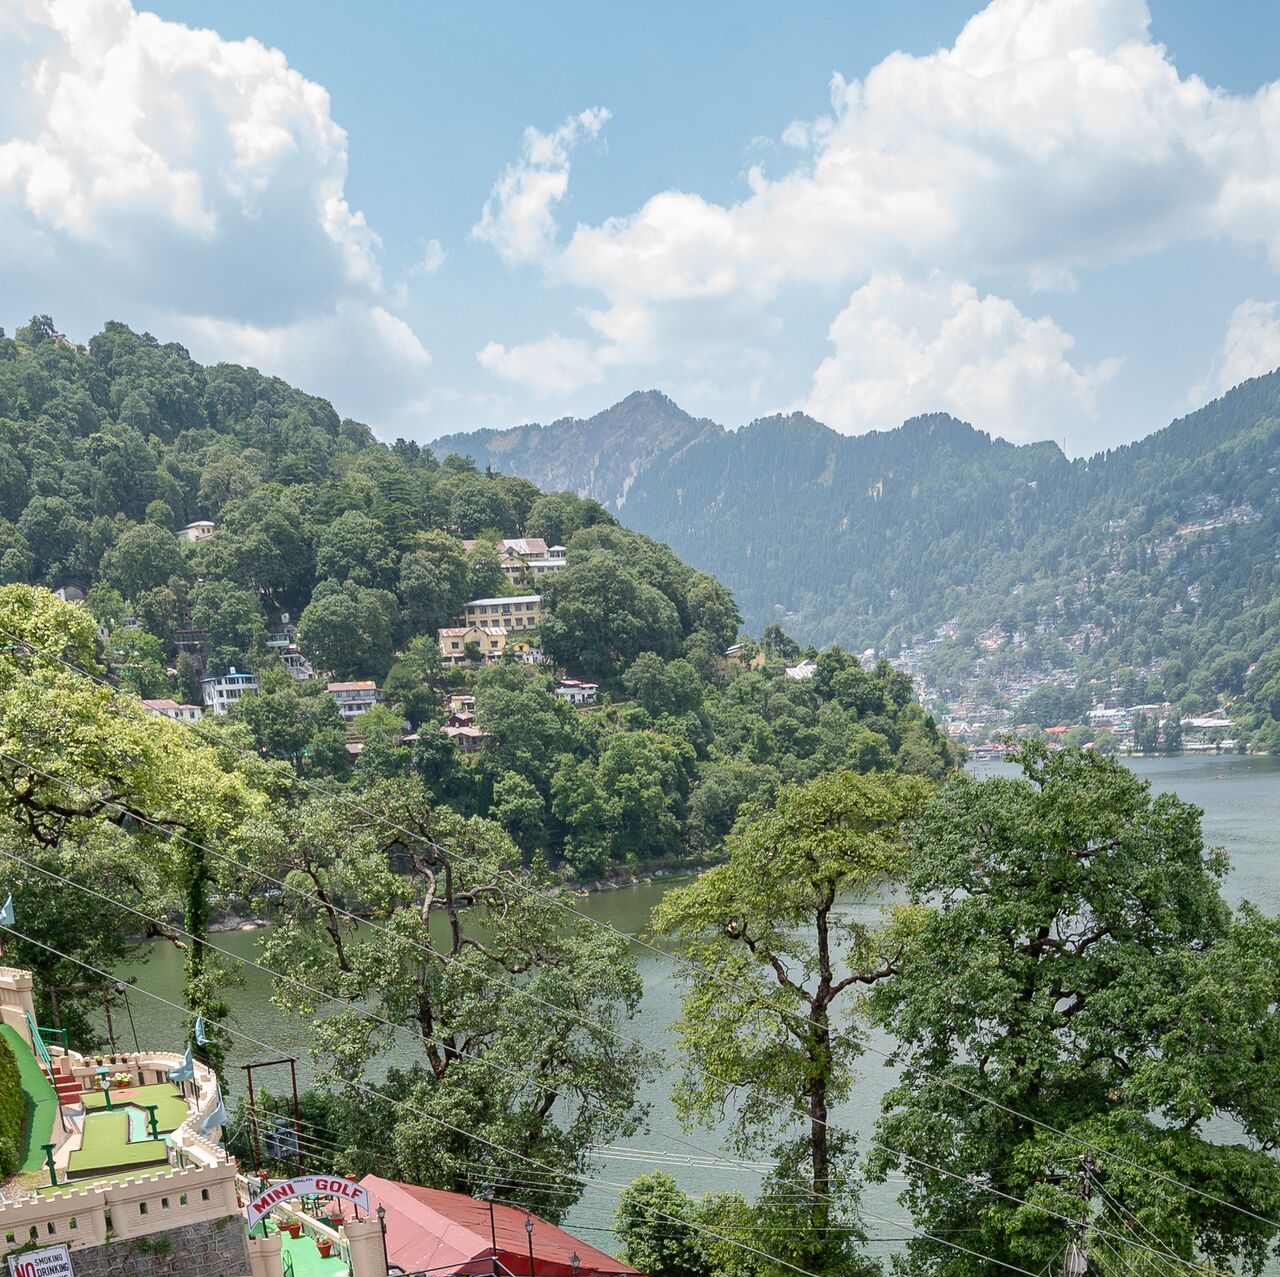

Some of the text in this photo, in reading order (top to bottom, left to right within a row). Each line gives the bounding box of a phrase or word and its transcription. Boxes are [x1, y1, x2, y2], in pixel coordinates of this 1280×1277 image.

[253, 1178, 363, 1214] MINI GOLF
[34, 1253, 63, 1266] SMOKING
[36, 1262, 69, 1277] DRINKING
